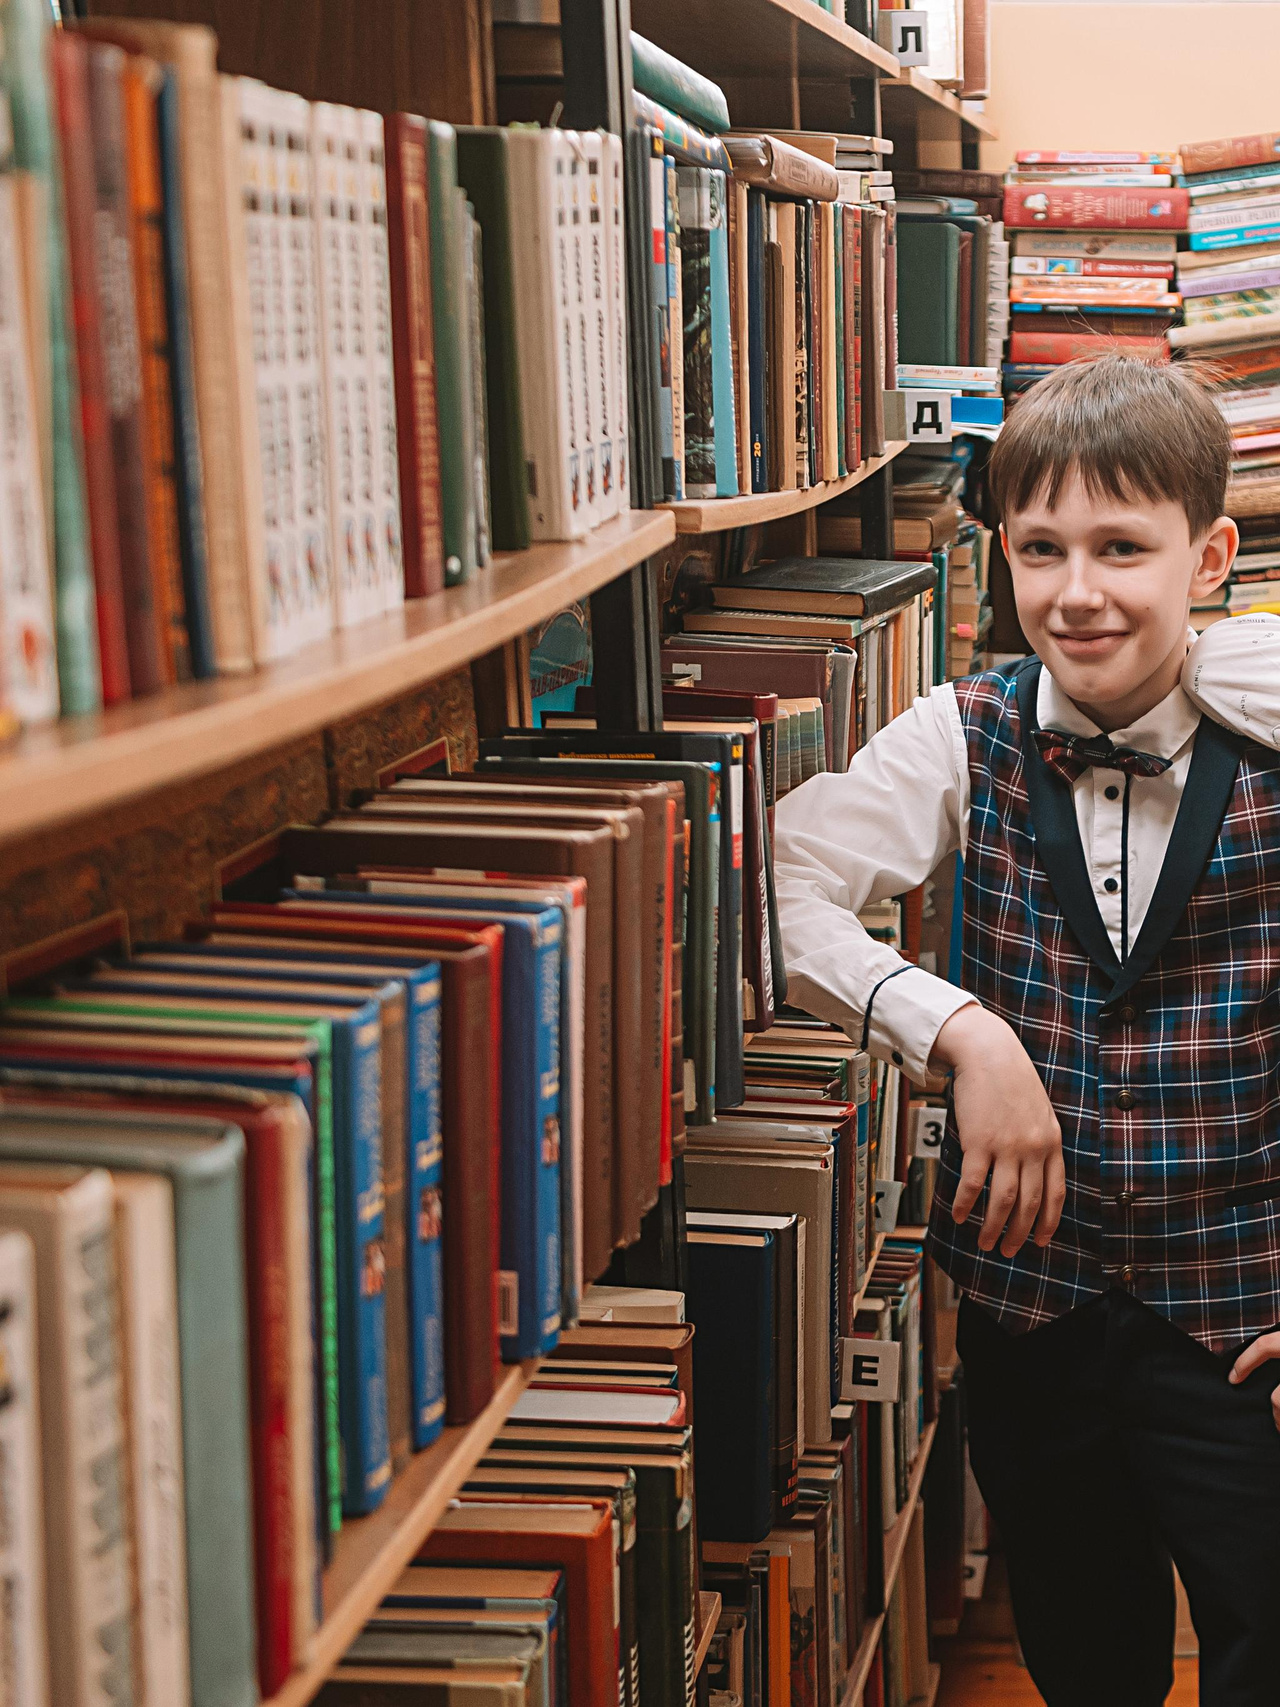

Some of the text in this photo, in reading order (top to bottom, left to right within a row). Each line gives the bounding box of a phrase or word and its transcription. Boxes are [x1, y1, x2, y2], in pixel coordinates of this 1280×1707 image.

[898, 25, 923, 54] Л
[913, 401, 942, 434] Д
[753, 442, 761, 457] 20
[1194, 664, 1203, 693] GENIUS
[852, 1355, 880, 1387] Е
